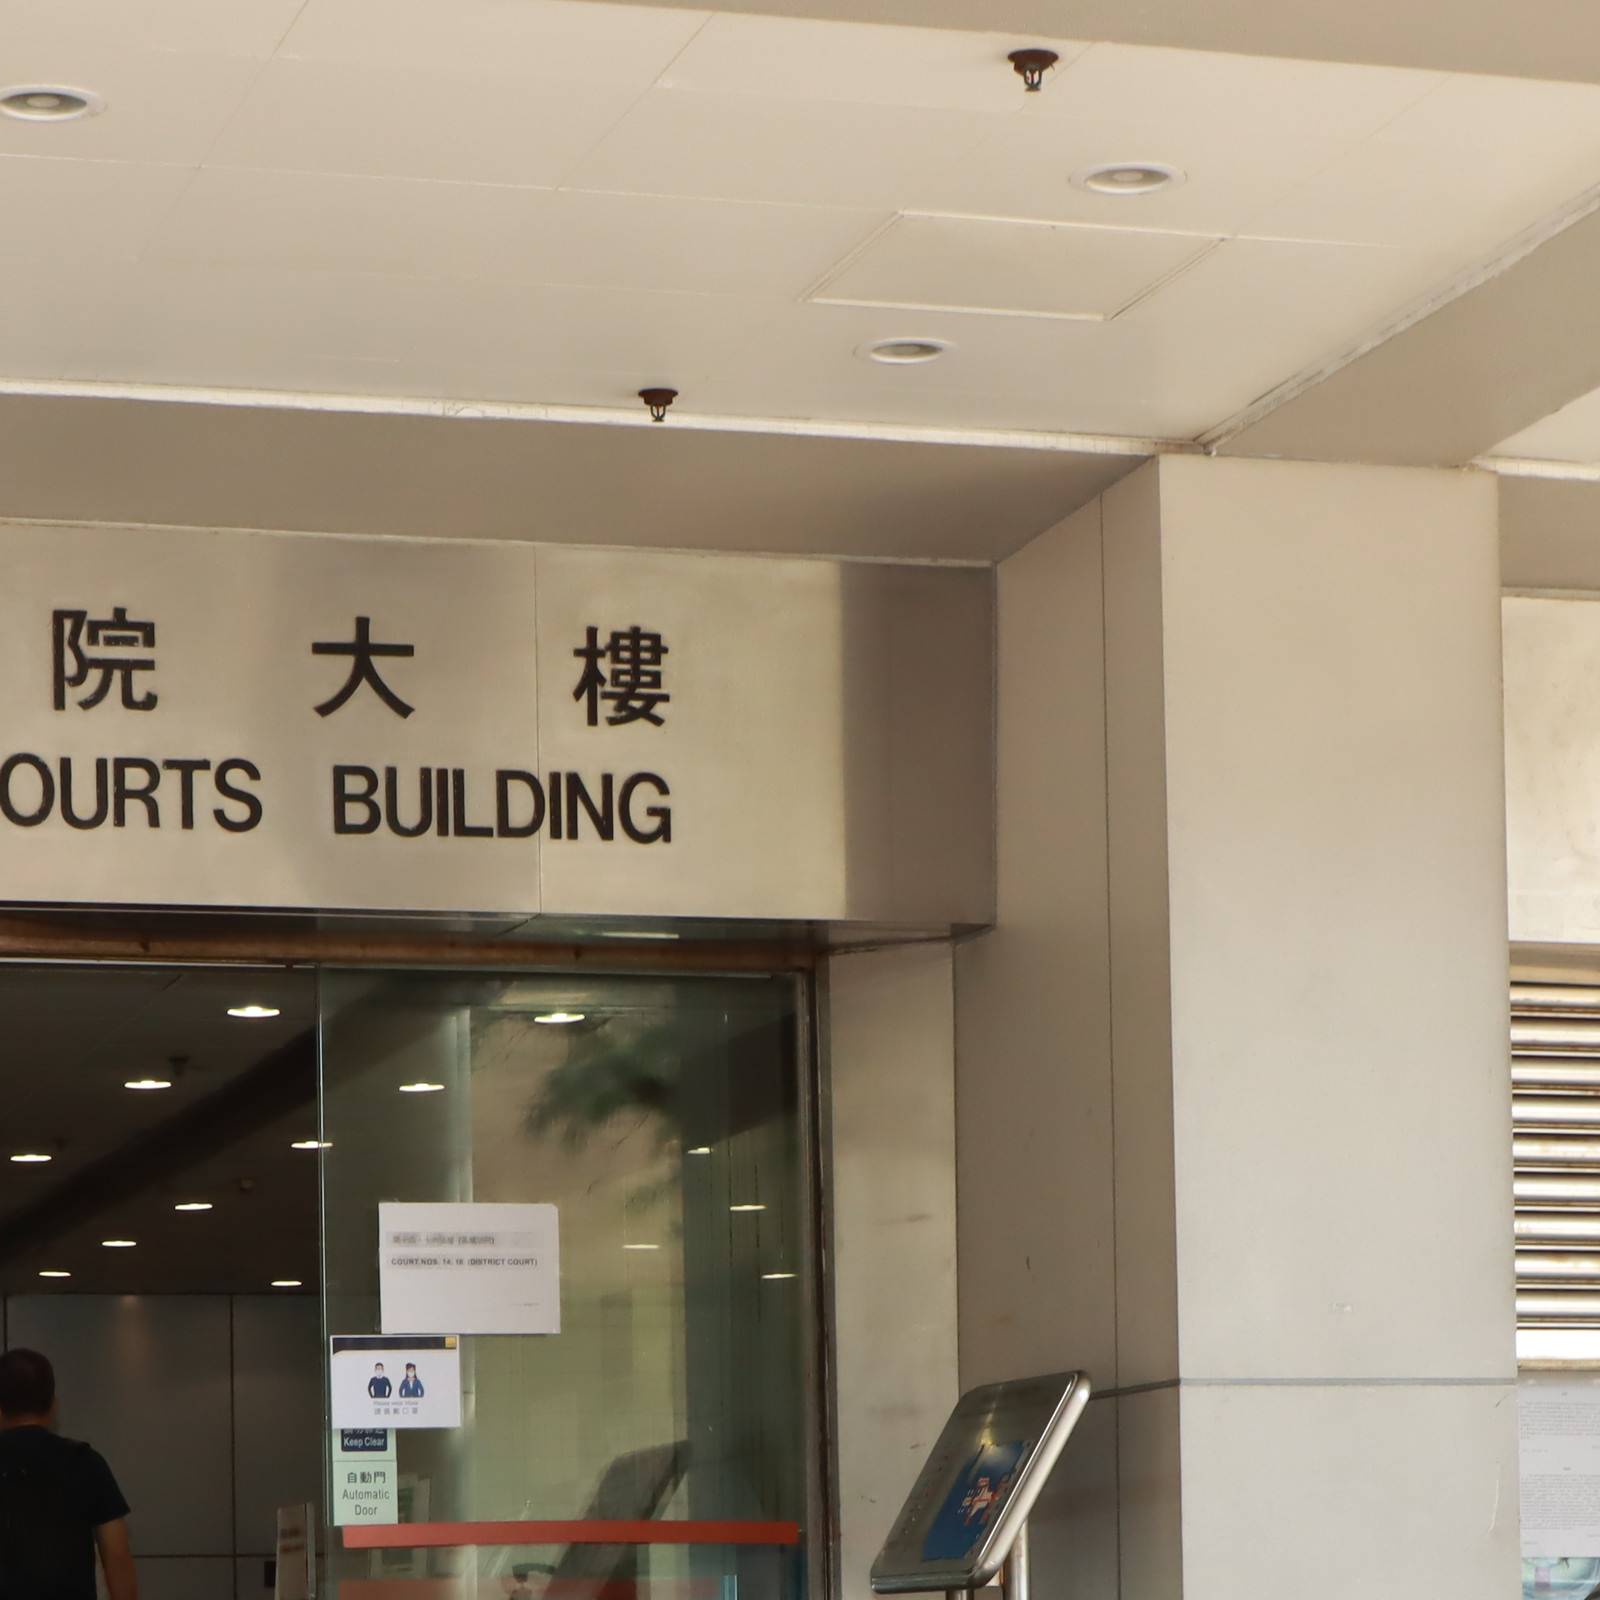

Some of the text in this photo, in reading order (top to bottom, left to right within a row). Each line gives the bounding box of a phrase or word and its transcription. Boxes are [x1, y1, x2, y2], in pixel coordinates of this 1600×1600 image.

[332, 763, 672, 844] BUILDING
[391, 1258, 421, 1266] COURT
[343, 1437, 385, 1448] Keep Clear
[347, 1471, 386, 1484] 自動門
[342, 1489, 390, 1500] Automatic
[354, 1504, 378, 1516] Door
